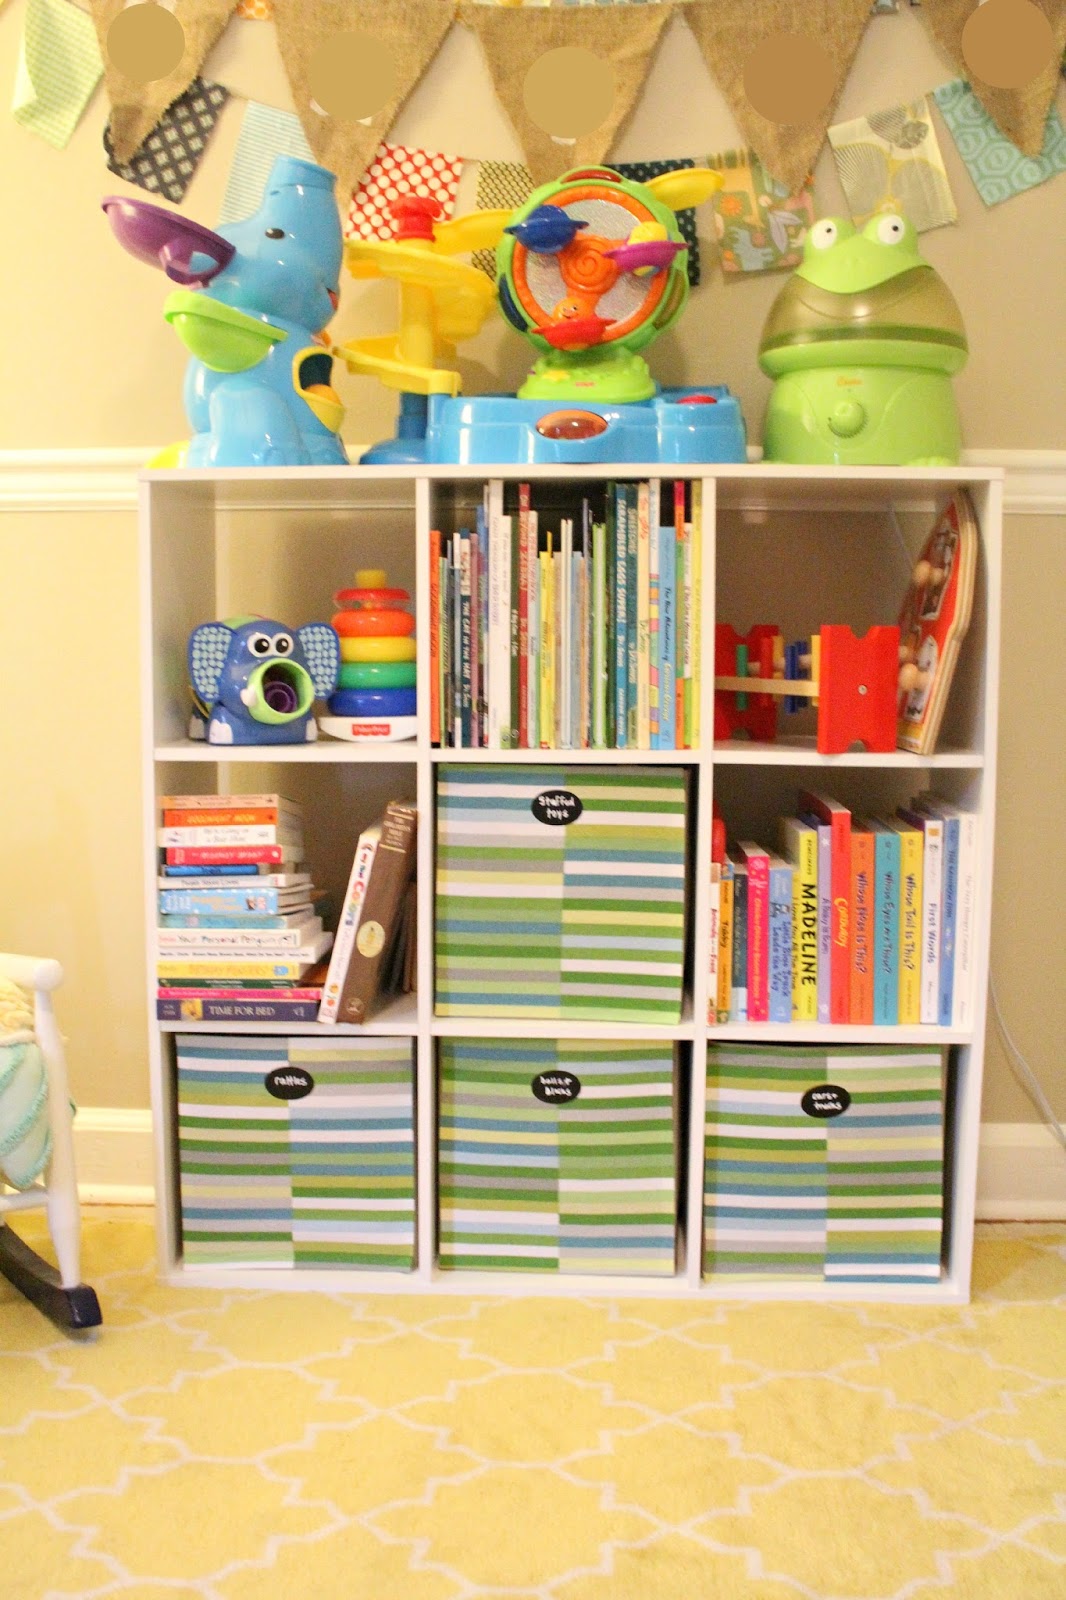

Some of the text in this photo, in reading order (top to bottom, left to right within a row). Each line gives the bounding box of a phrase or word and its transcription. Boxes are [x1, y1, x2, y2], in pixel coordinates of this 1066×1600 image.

[664, 587, 672, 598] The
[857, 872, 868, 903] Whose
[905, 873, 916, 906] Whose
[882, 902, 895, 924] Eyes
[906, 908, 916, 928] Tail
[801, 883, 817, 986] MADELINE
[927, 903, 937, 964] First Words
[904, 942, 915, 970] This?
[208, 1005, 276, 1016] TIME FOR BED
